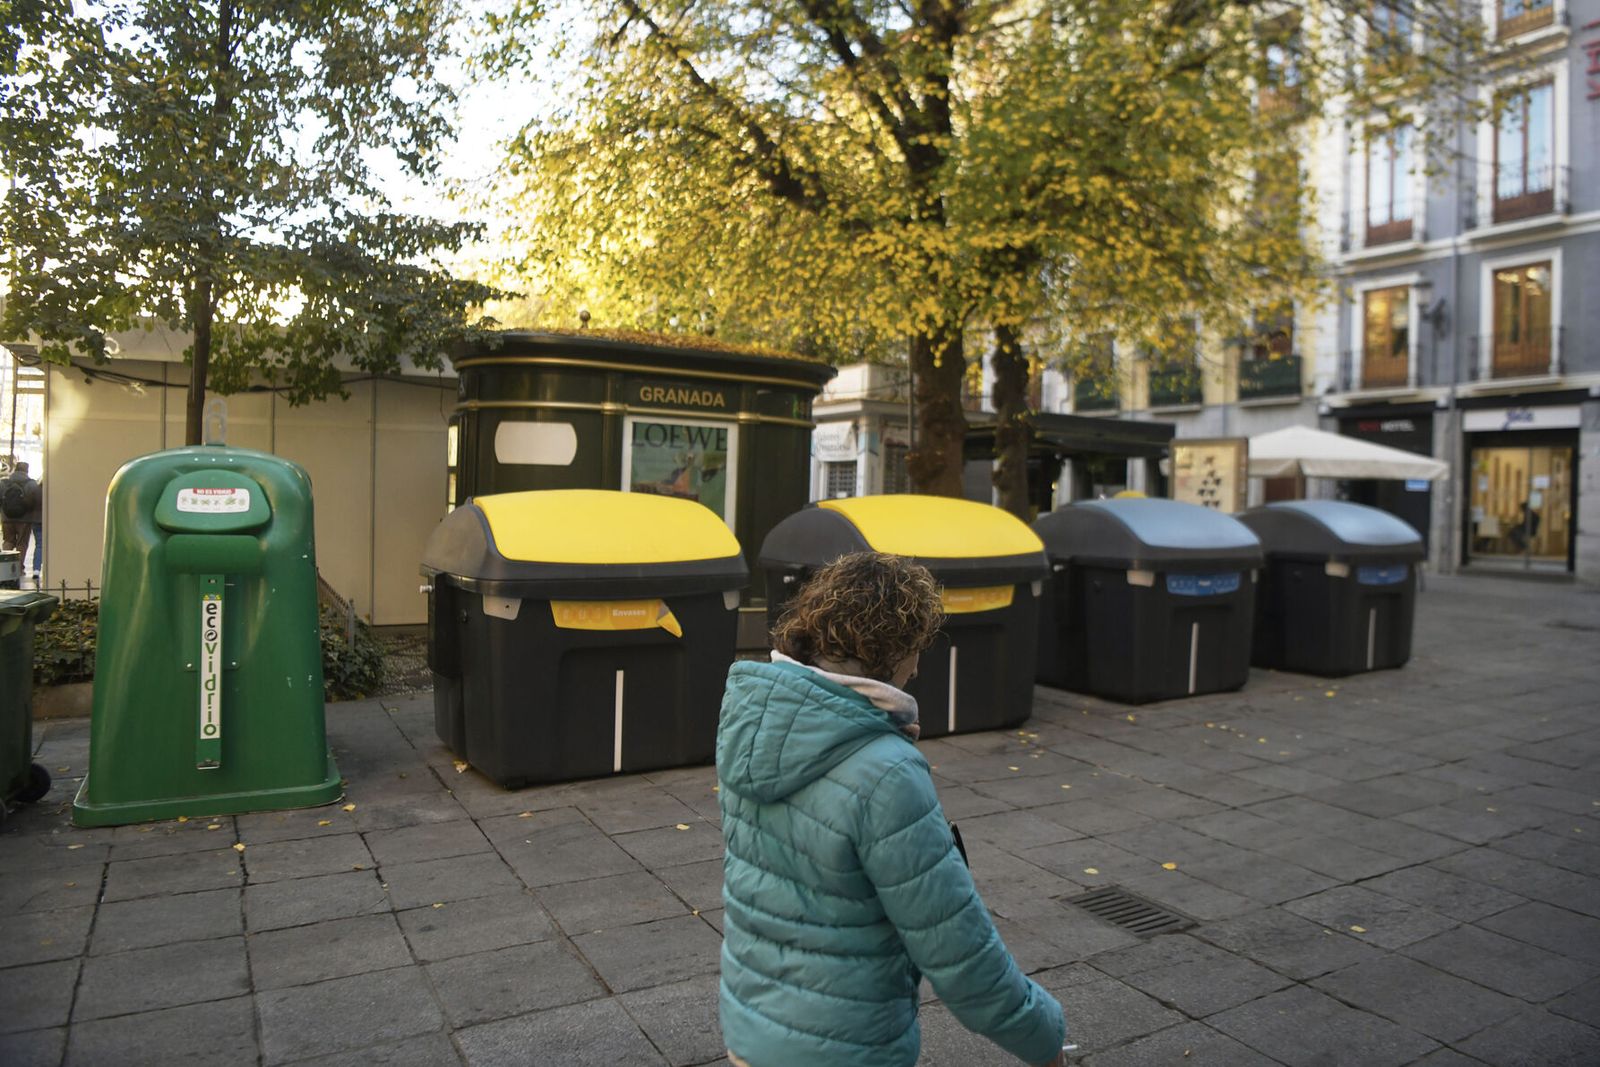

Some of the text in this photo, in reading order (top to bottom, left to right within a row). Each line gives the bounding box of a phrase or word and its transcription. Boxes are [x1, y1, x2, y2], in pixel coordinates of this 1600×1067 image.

[640, 386, 725, 407] GRANADA
[632, 422, 728, 452] LOEWE
[203, 602, 218, 736] ecovidrio
